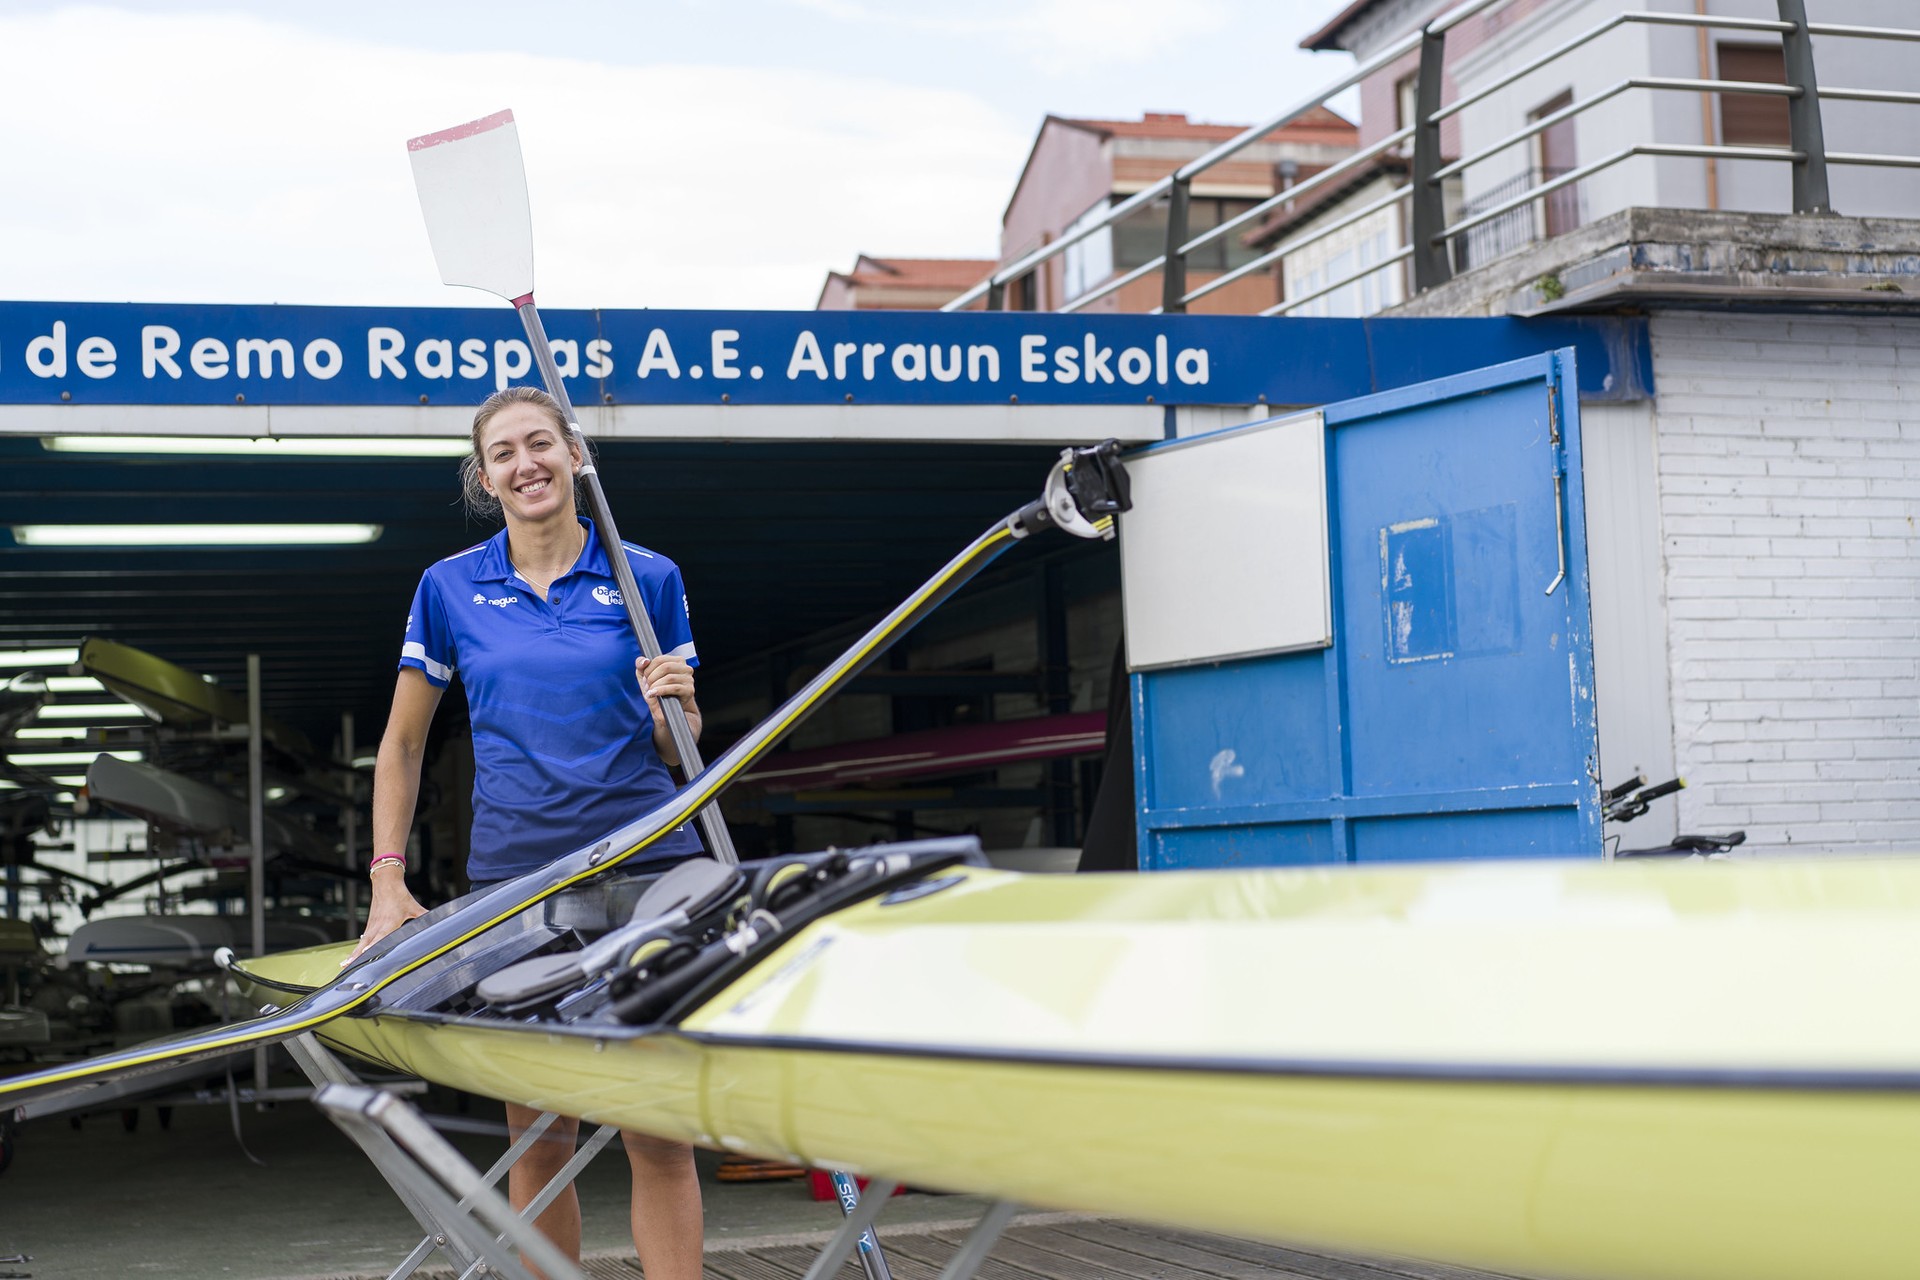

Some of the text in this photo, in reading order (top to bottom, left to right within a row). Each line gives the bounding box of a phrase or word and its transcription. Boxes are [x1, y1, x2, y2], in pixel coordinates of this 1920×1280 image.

[25, 320, 1210, 392] de Remo Raspas A.E. Arraun Eskola
[487, 596, 518, 608] negua
